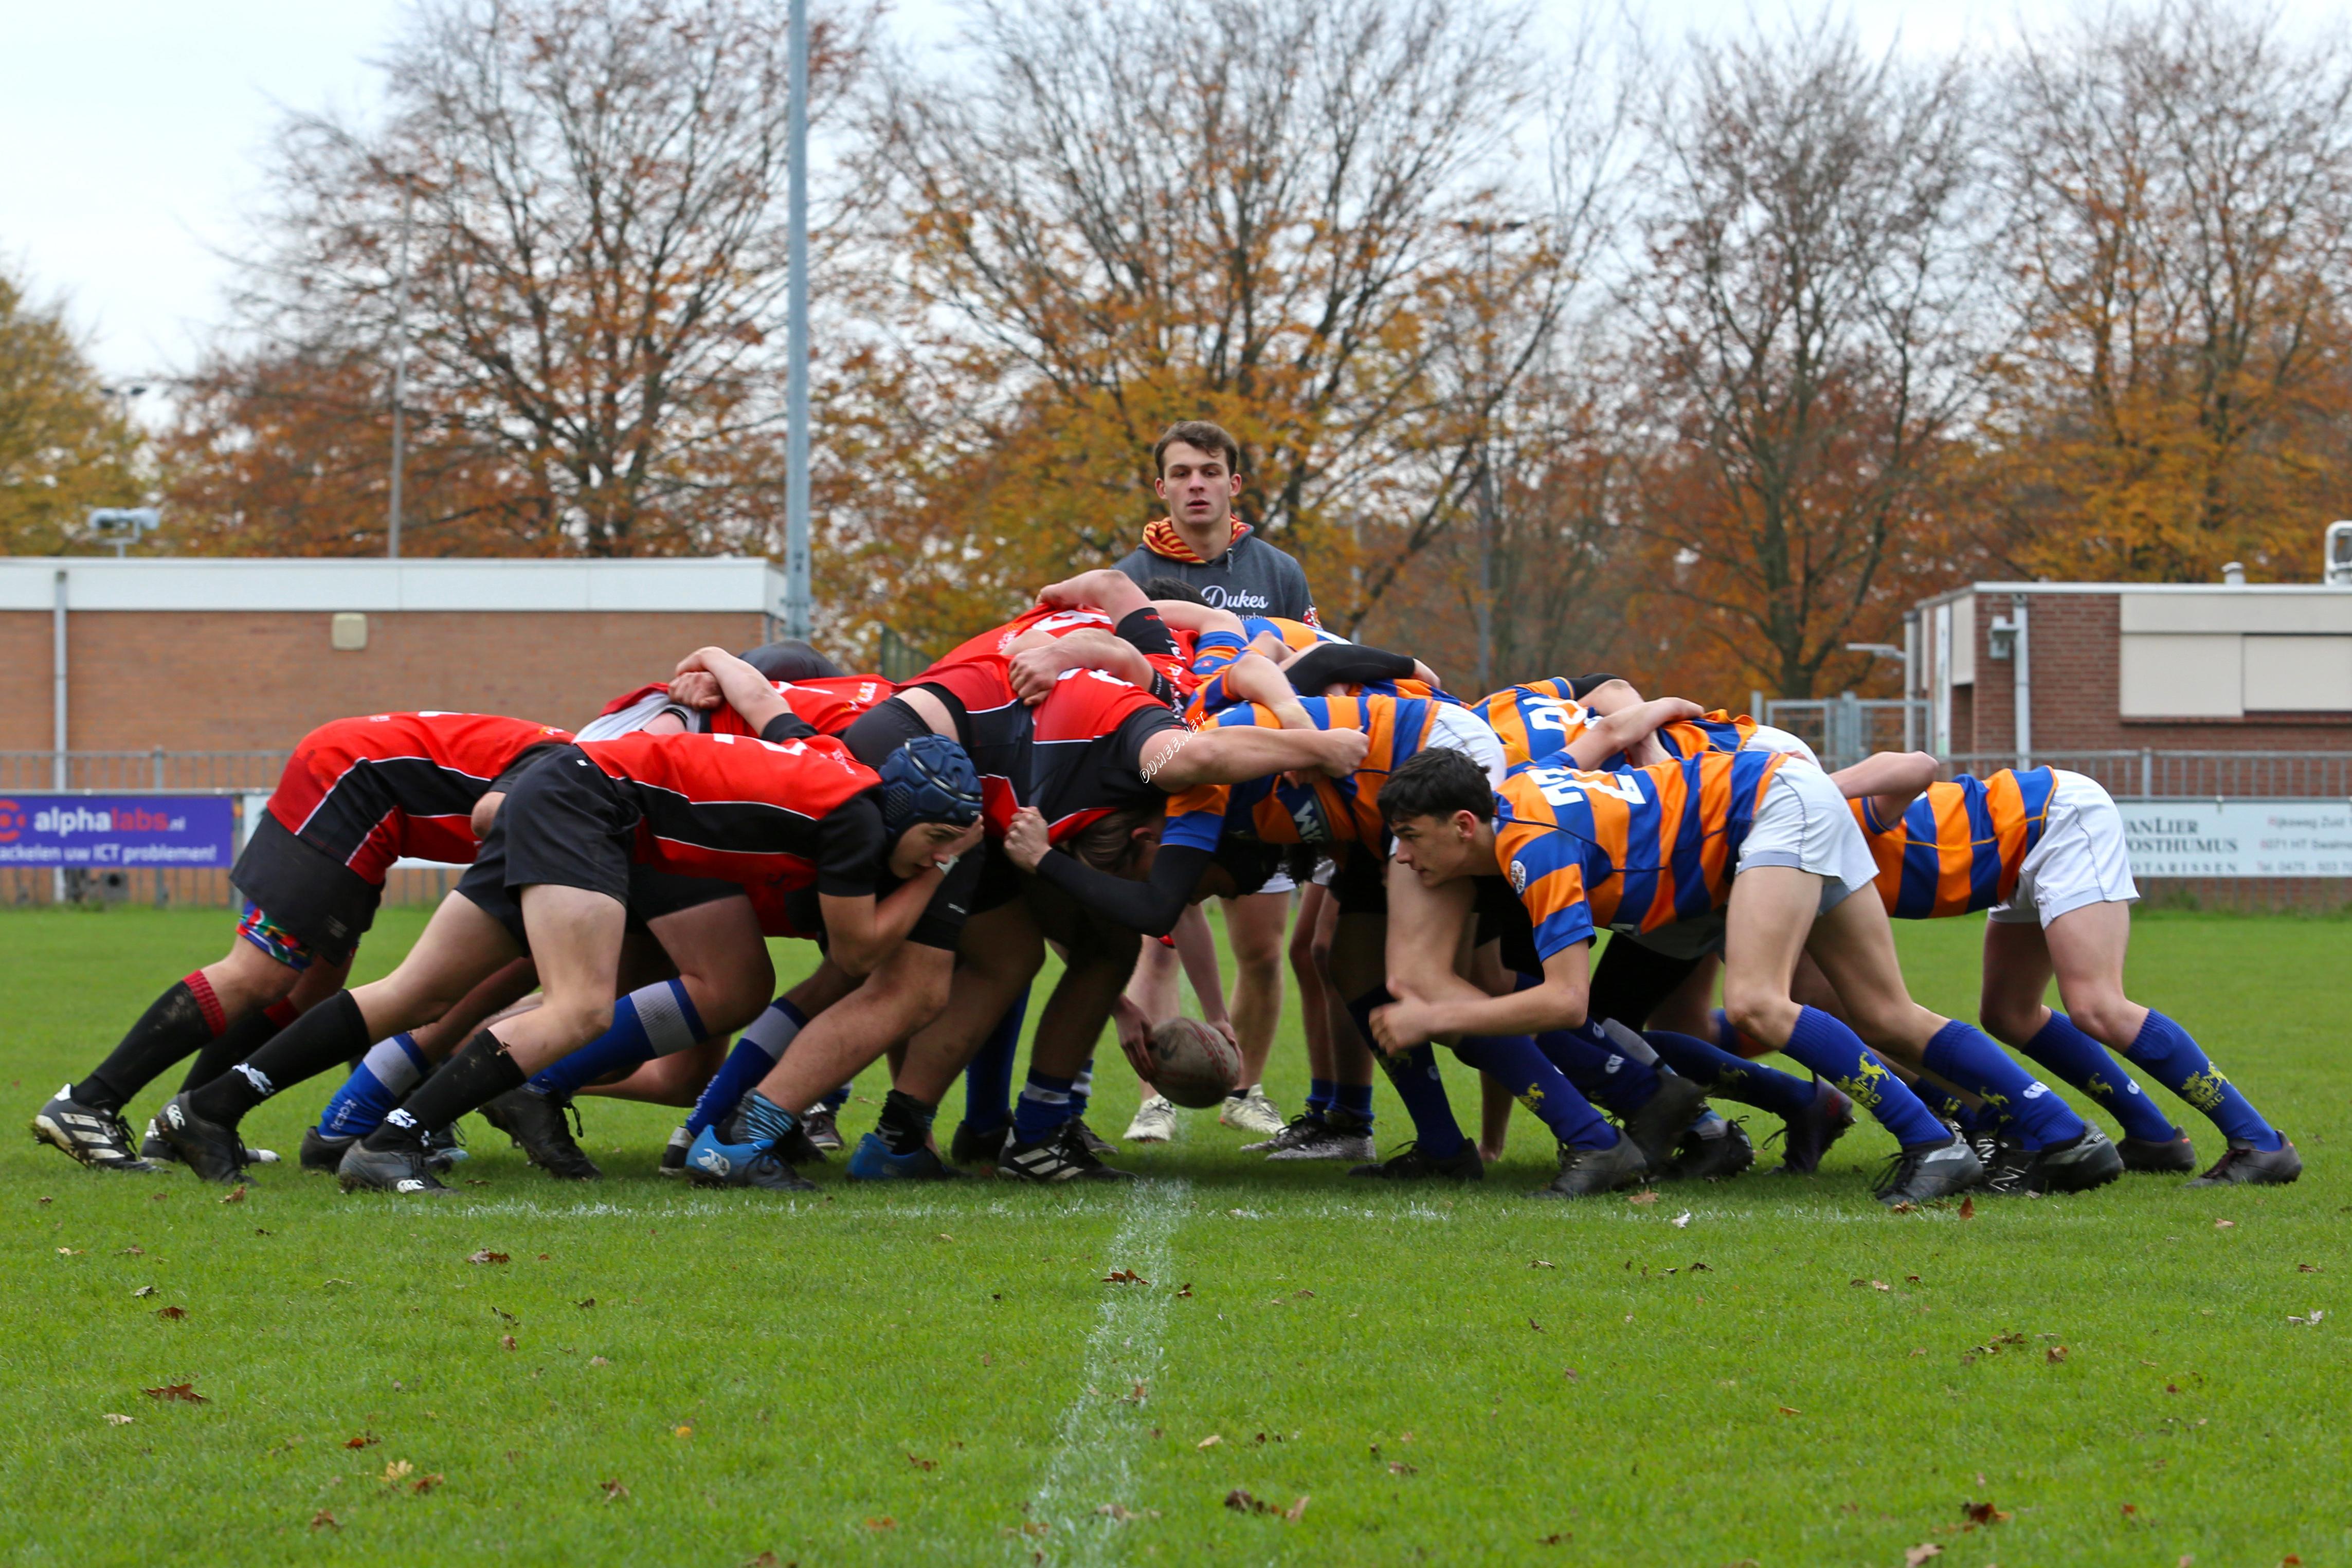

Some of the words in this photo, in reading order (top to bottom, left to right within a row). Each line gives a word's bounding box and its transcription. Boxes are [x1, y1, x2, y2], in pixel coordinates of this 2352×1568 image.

[1201, 585, 1269, 610] Dukes
[92, 844, 120, 860] ICT
[2126, 837, 2238, 852] OSTHUMUS
[2129, 861, 2237, 872] OTARISSEN
